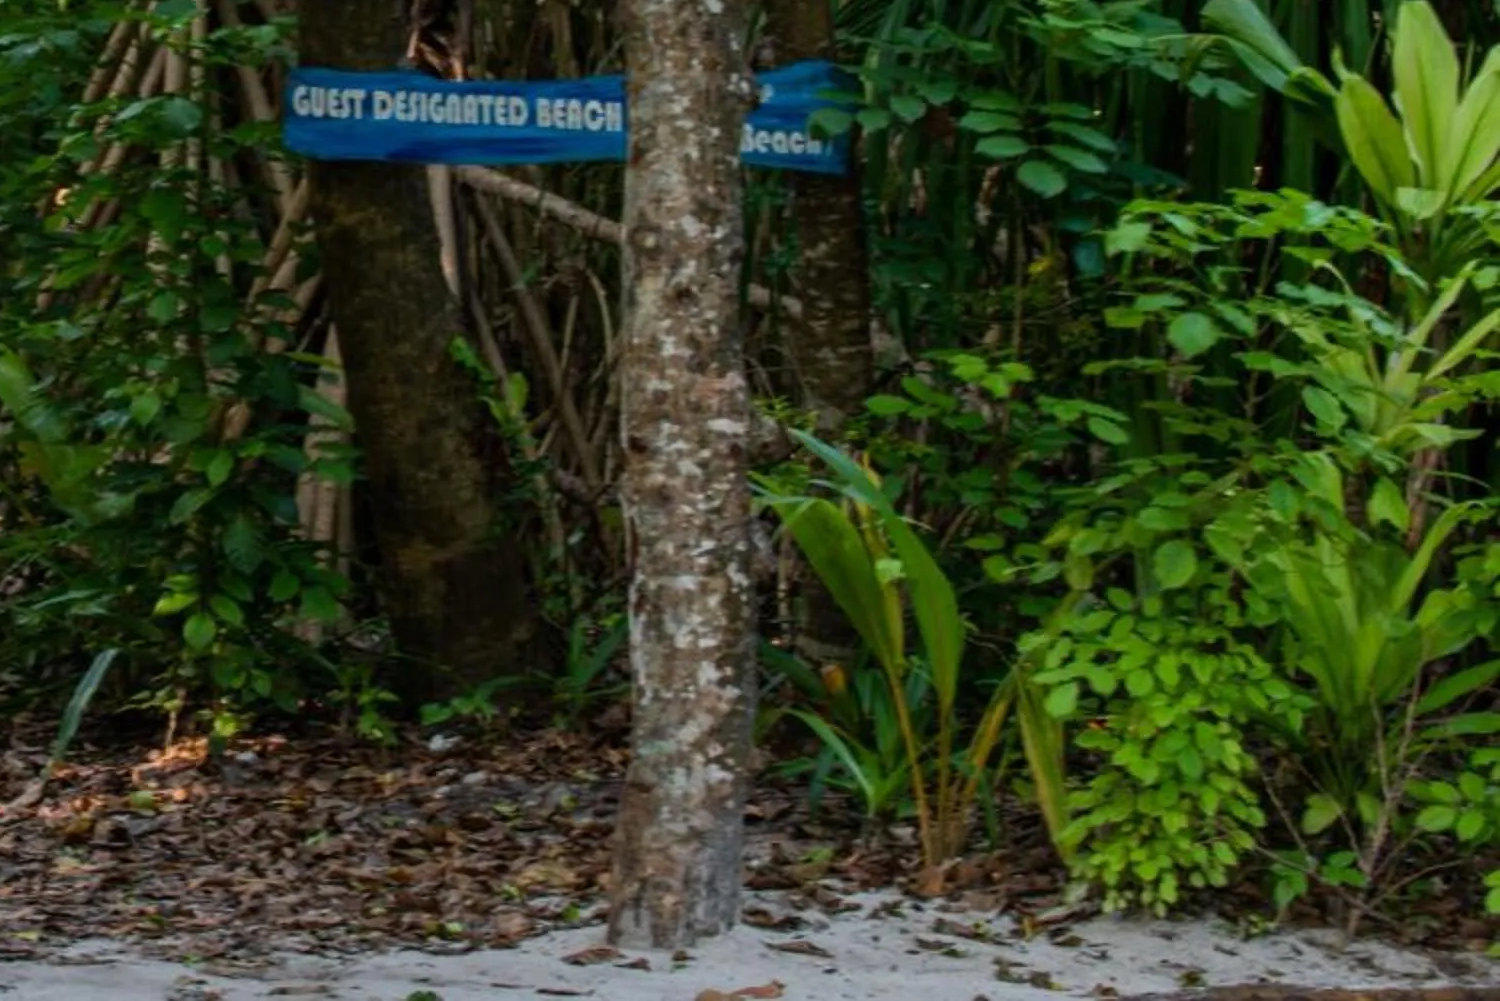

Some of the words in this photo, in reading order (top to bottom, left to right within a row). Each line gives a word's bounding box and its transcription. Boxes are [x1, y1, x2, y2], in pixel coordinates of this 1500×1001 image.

[292, 85, 367, 120] GUEST
[372, 88, 529, 127] DESIGNATED
[536, 97, 623, 132] BEACH
